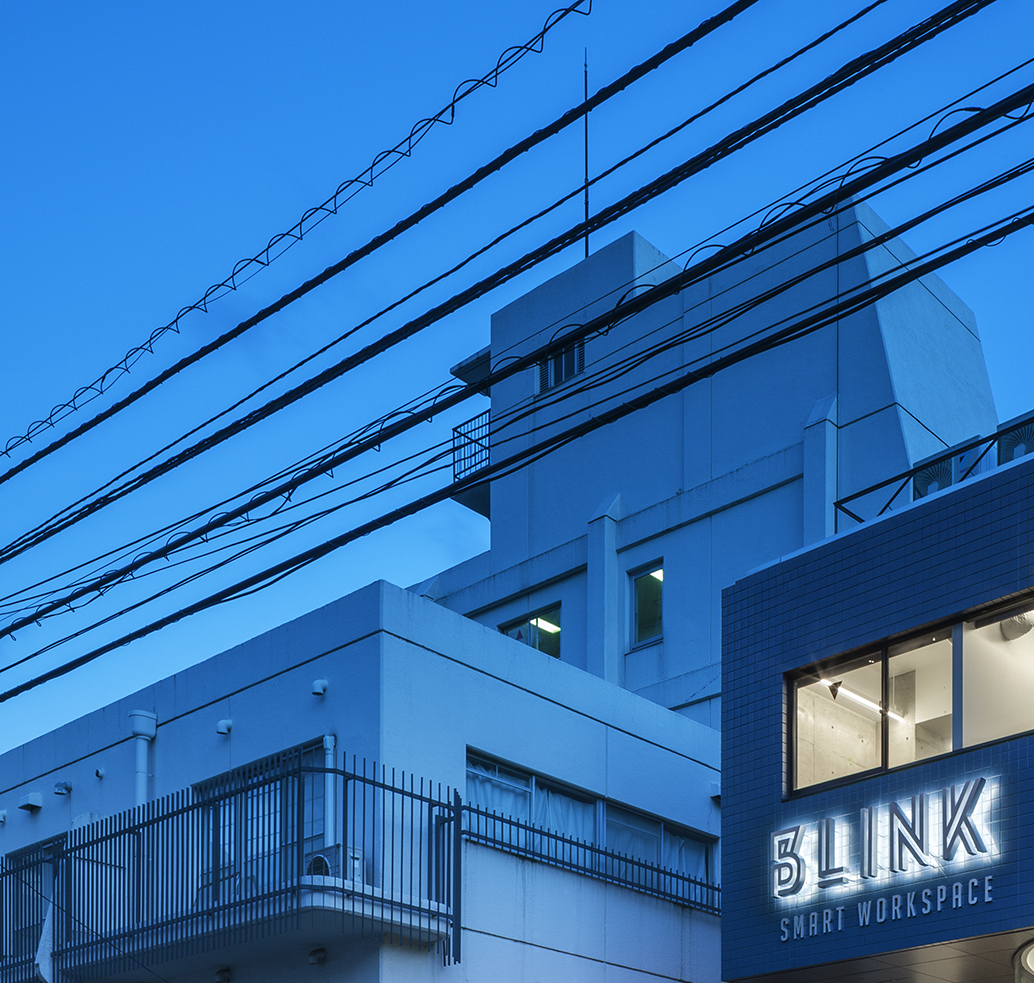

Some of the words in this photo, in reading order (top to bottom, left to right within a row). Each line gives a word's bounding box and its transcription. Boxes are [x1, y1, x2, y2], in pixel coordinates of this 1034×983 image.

[771, 777, 986, 898] BLINK
[780, 906, 844, 942] SMART
[857, 875, 993, 927] WORKSPACE
